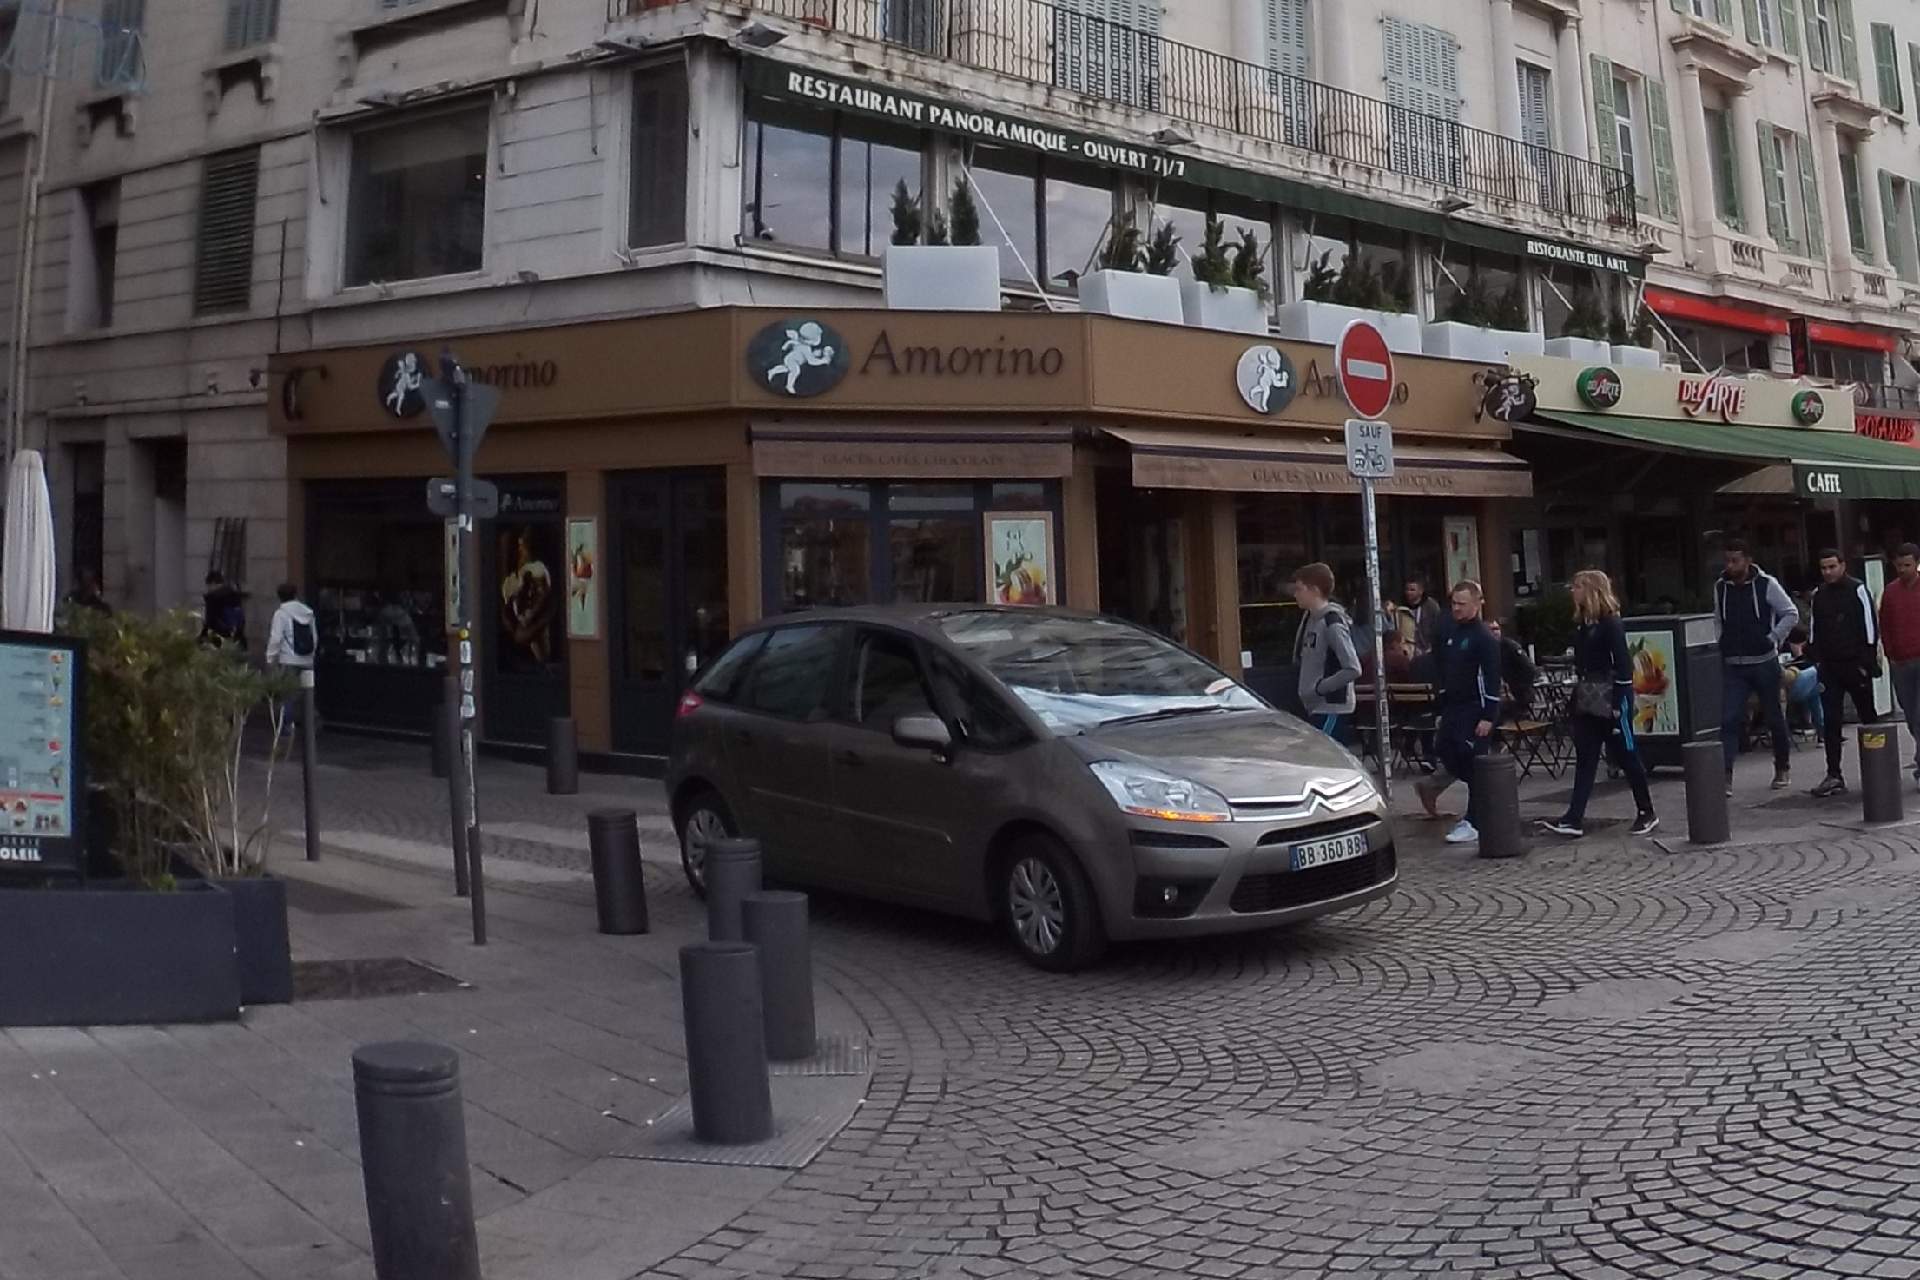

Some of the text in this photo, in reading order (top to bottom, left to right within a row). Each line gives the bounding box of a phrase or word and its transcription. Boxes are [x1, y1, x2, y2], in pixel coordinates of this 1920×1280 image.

[787, 72, 924, 121] RESTAURANT
[929, 104, 1068, 152] PANORAMIQUE
[1083, 141, 1149, 169] OUVERT
[1526, 240, 1586, 264] RISTORANTE
[859, 328, 1065, 377] Amorino
[460, 351, 558, 387] morino
[1359, 424, 1383, 439] SAUF
[0, 846, 43, 862] OLEIL
